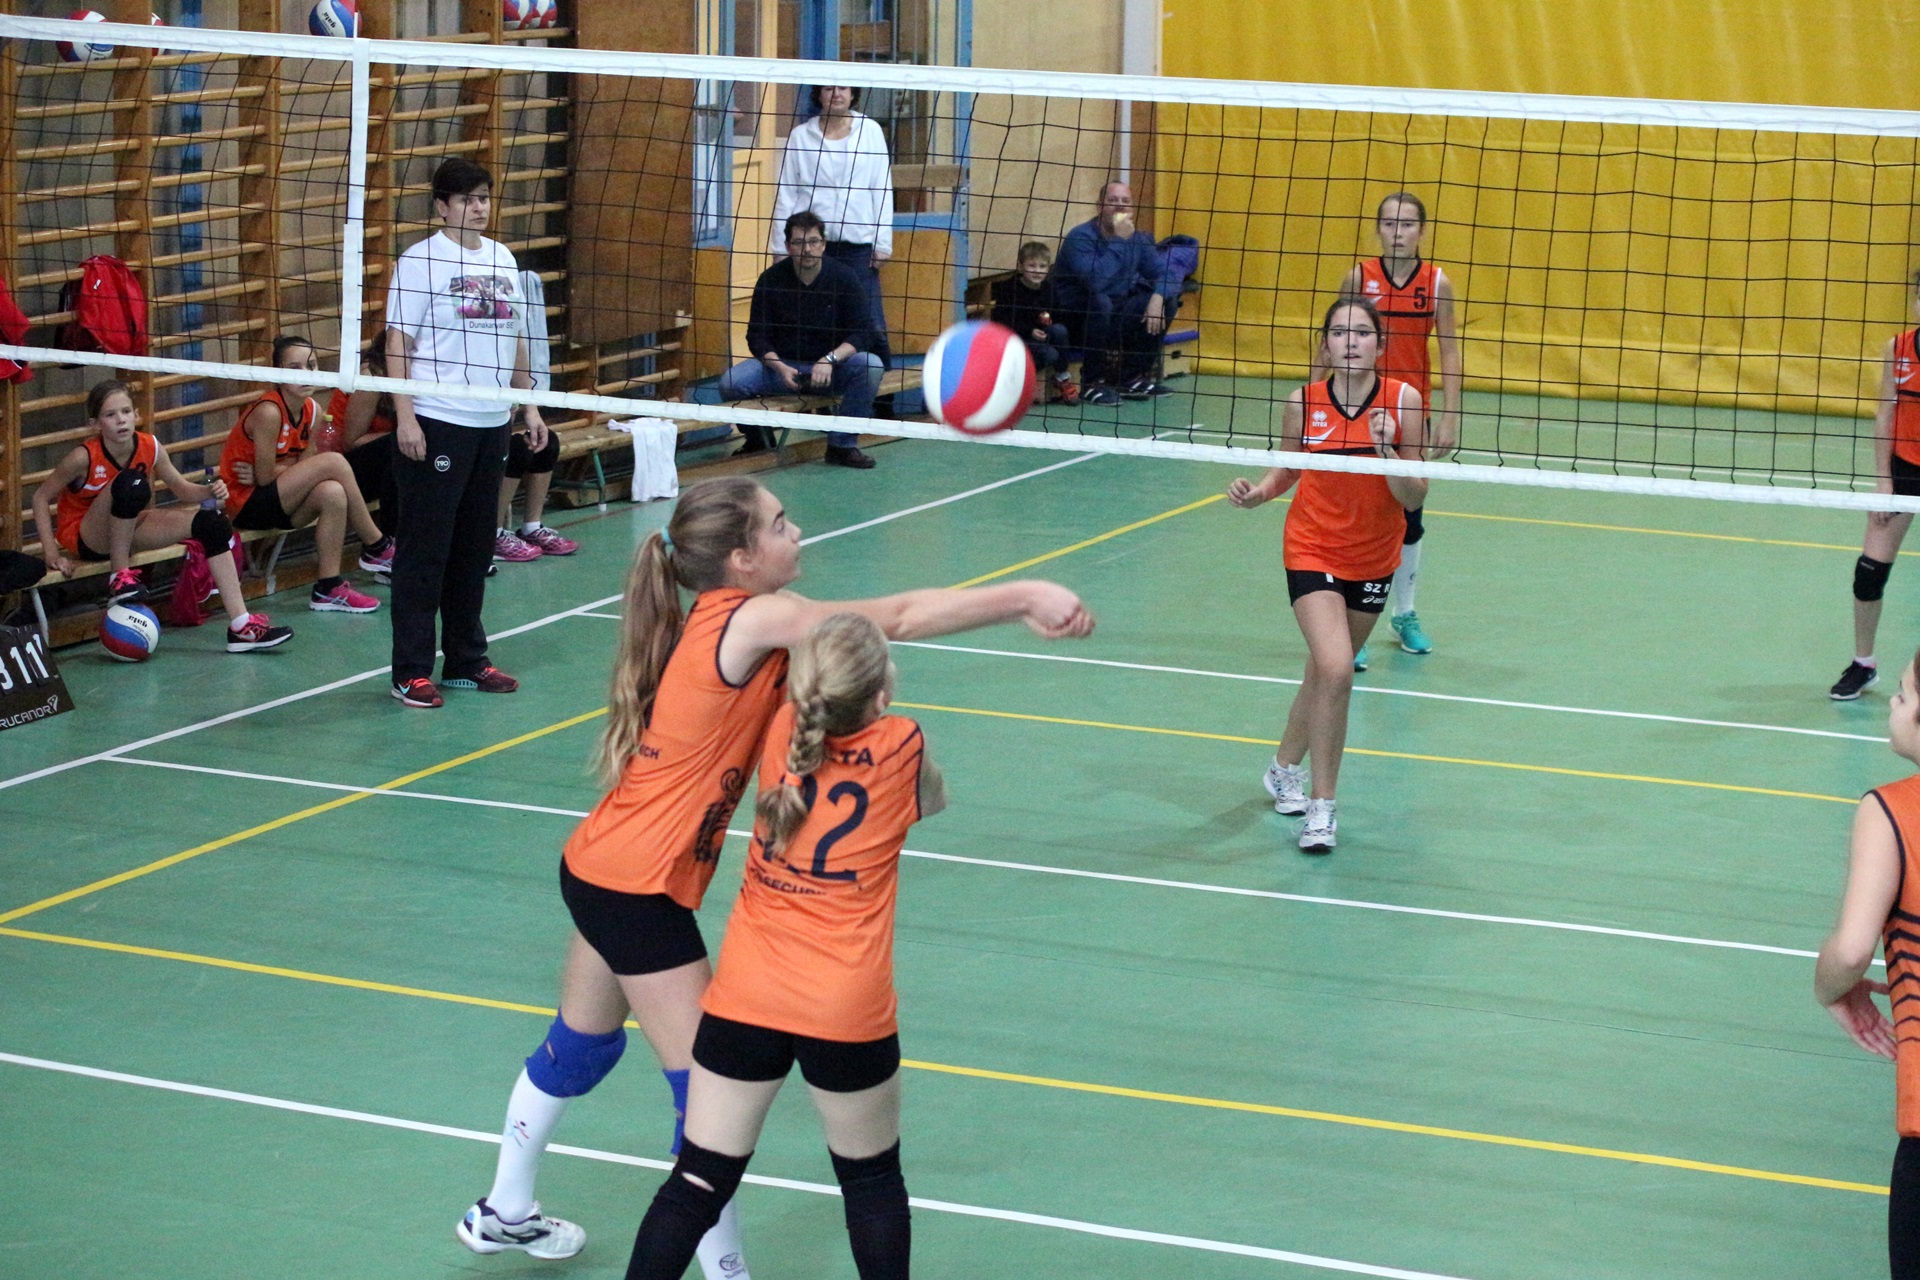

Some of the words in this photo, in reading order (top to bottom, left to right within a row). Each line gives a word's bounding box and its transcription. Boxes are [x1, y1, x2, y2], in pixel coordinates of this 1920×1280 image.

[1413, 286, 1427, 310] 5
[1363, 582, 1382, 593] SZ
[128, 615, 148, 628] gala
